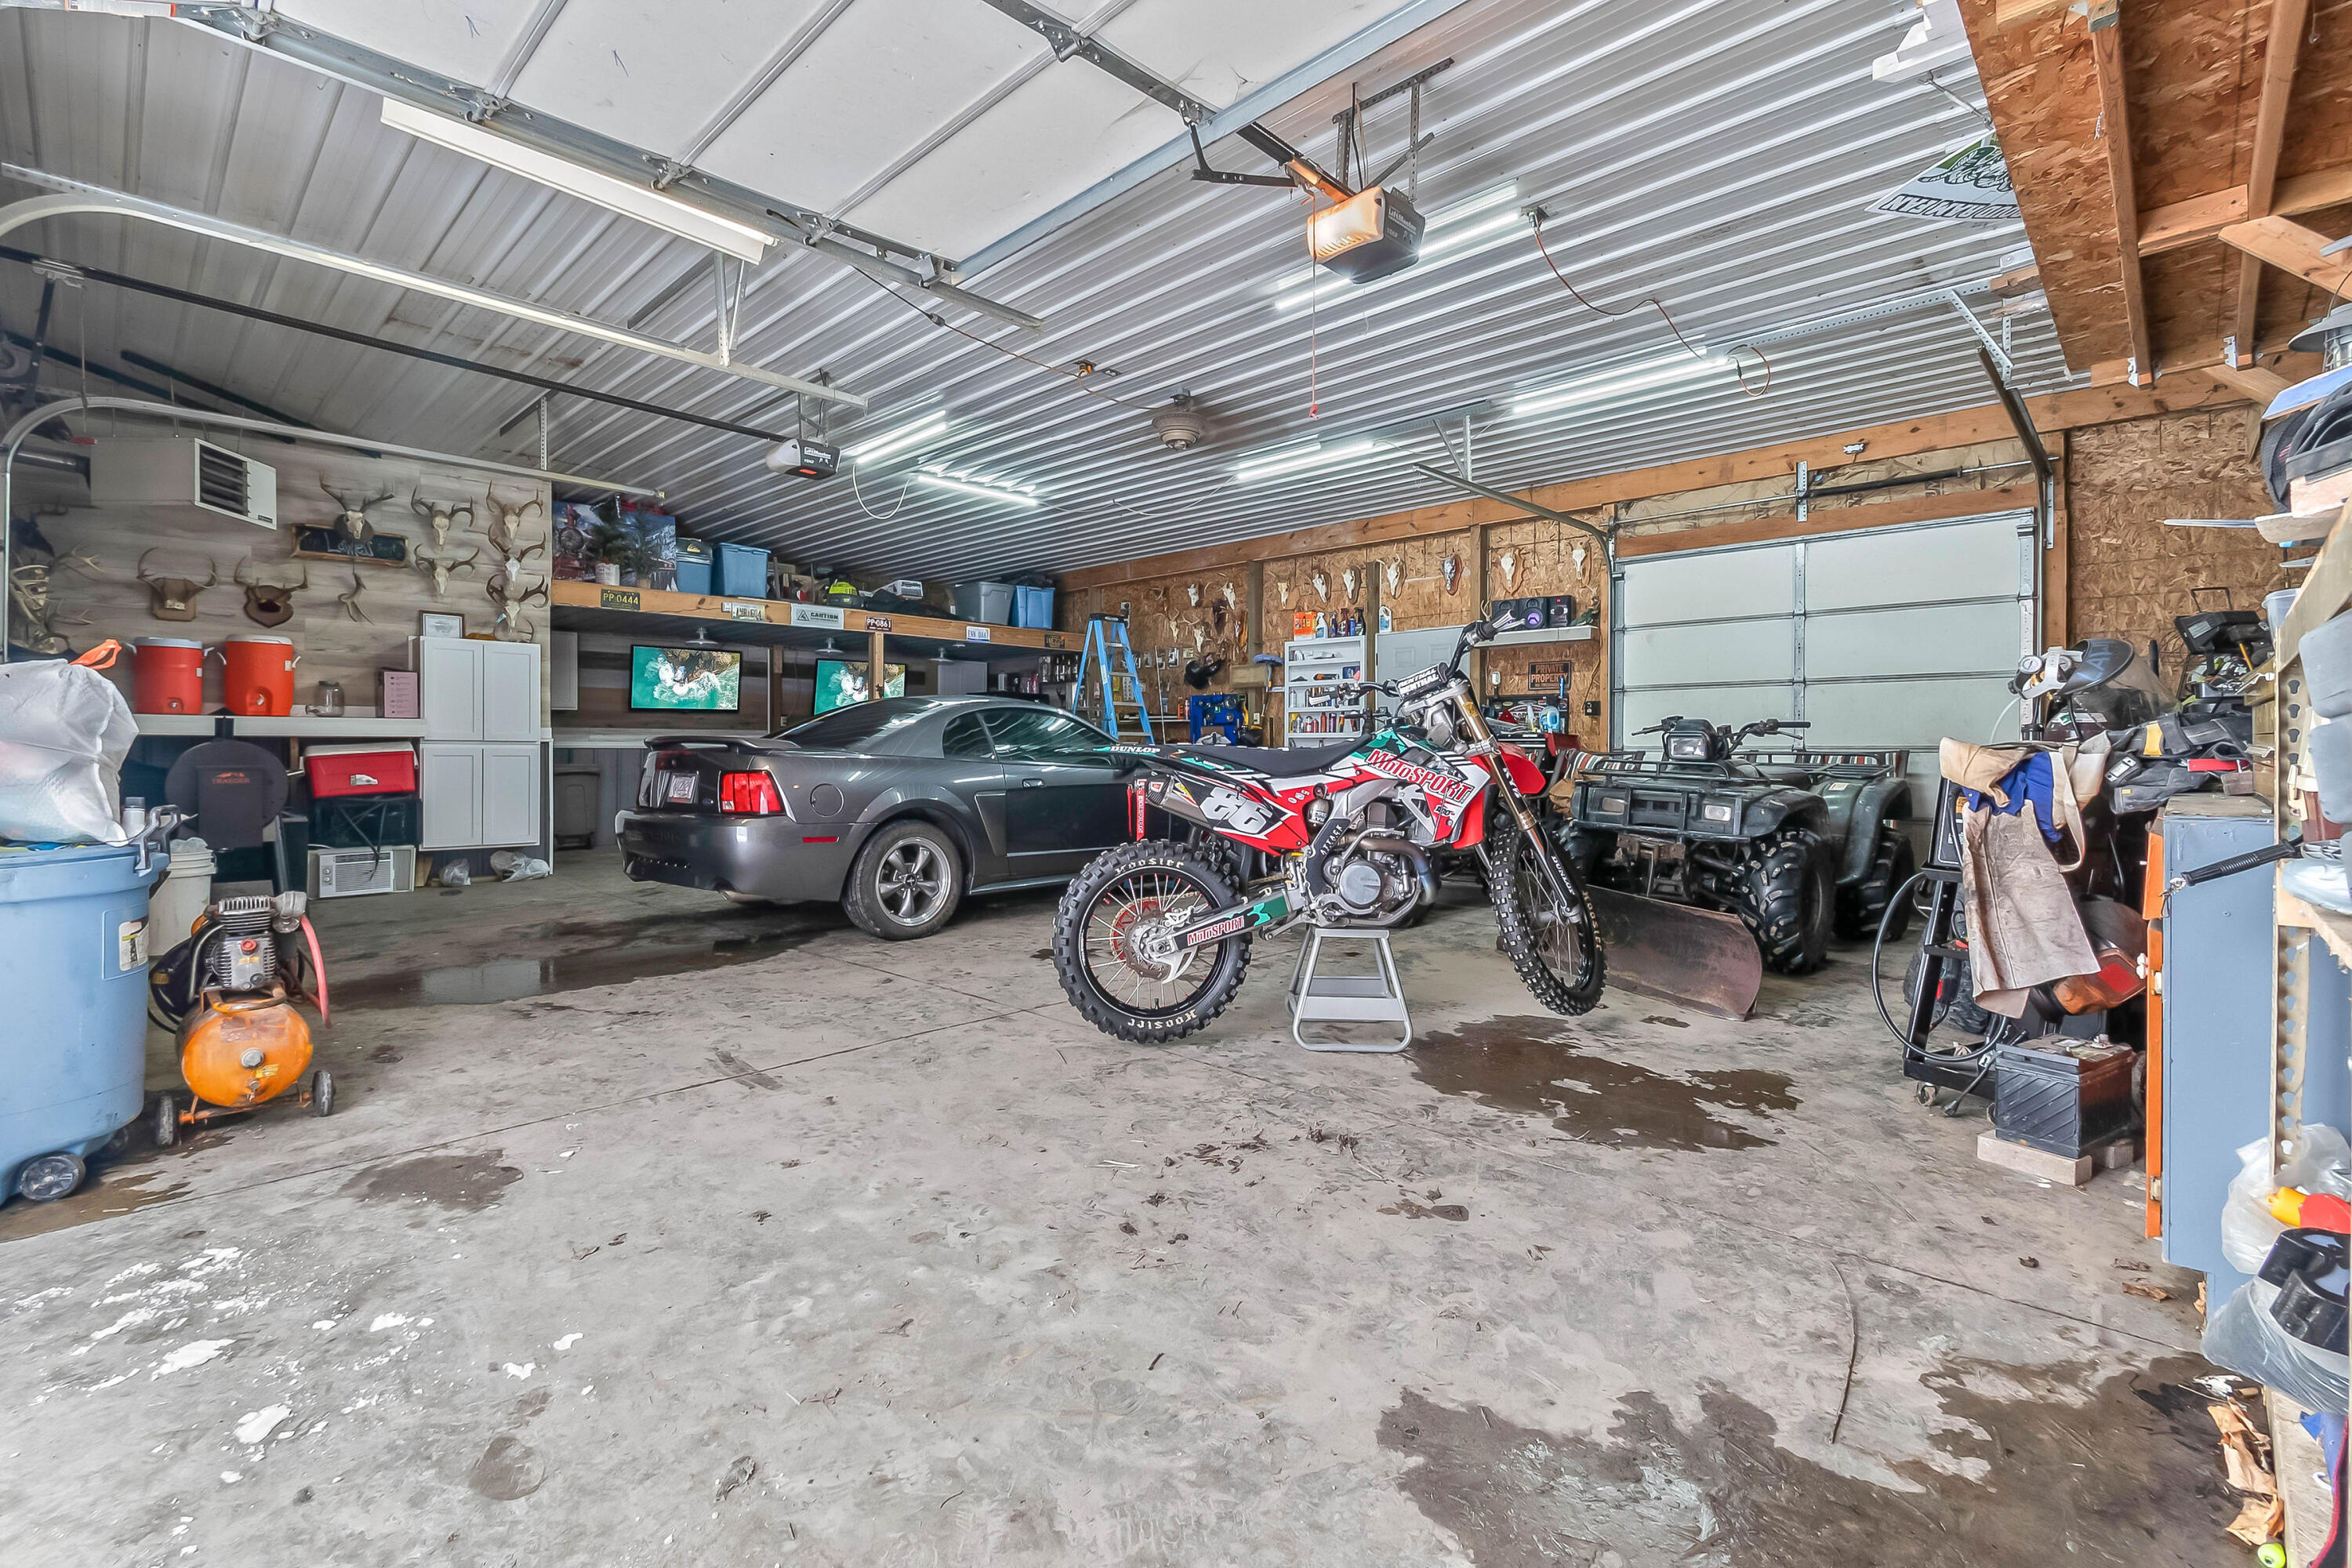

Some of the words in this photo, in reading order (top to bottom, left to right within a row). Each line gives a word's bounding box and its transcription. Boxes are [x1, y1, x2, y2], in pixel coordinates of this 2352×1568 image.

[1878, 194, 1940, 216] FAN
[1922, 199, 1991, 219] RAM
[1535, 664, 1564, 673] PRIVATE
[1199, 786, 1273, 834] 86
[1320, 824, 1343, 856] ATTACK
[1114, 857, 1185, 876] Hoosier
[1551, 855, 1576, 895] DUNLOP
[1127, 1008, 1198, 1030] Hoosier
